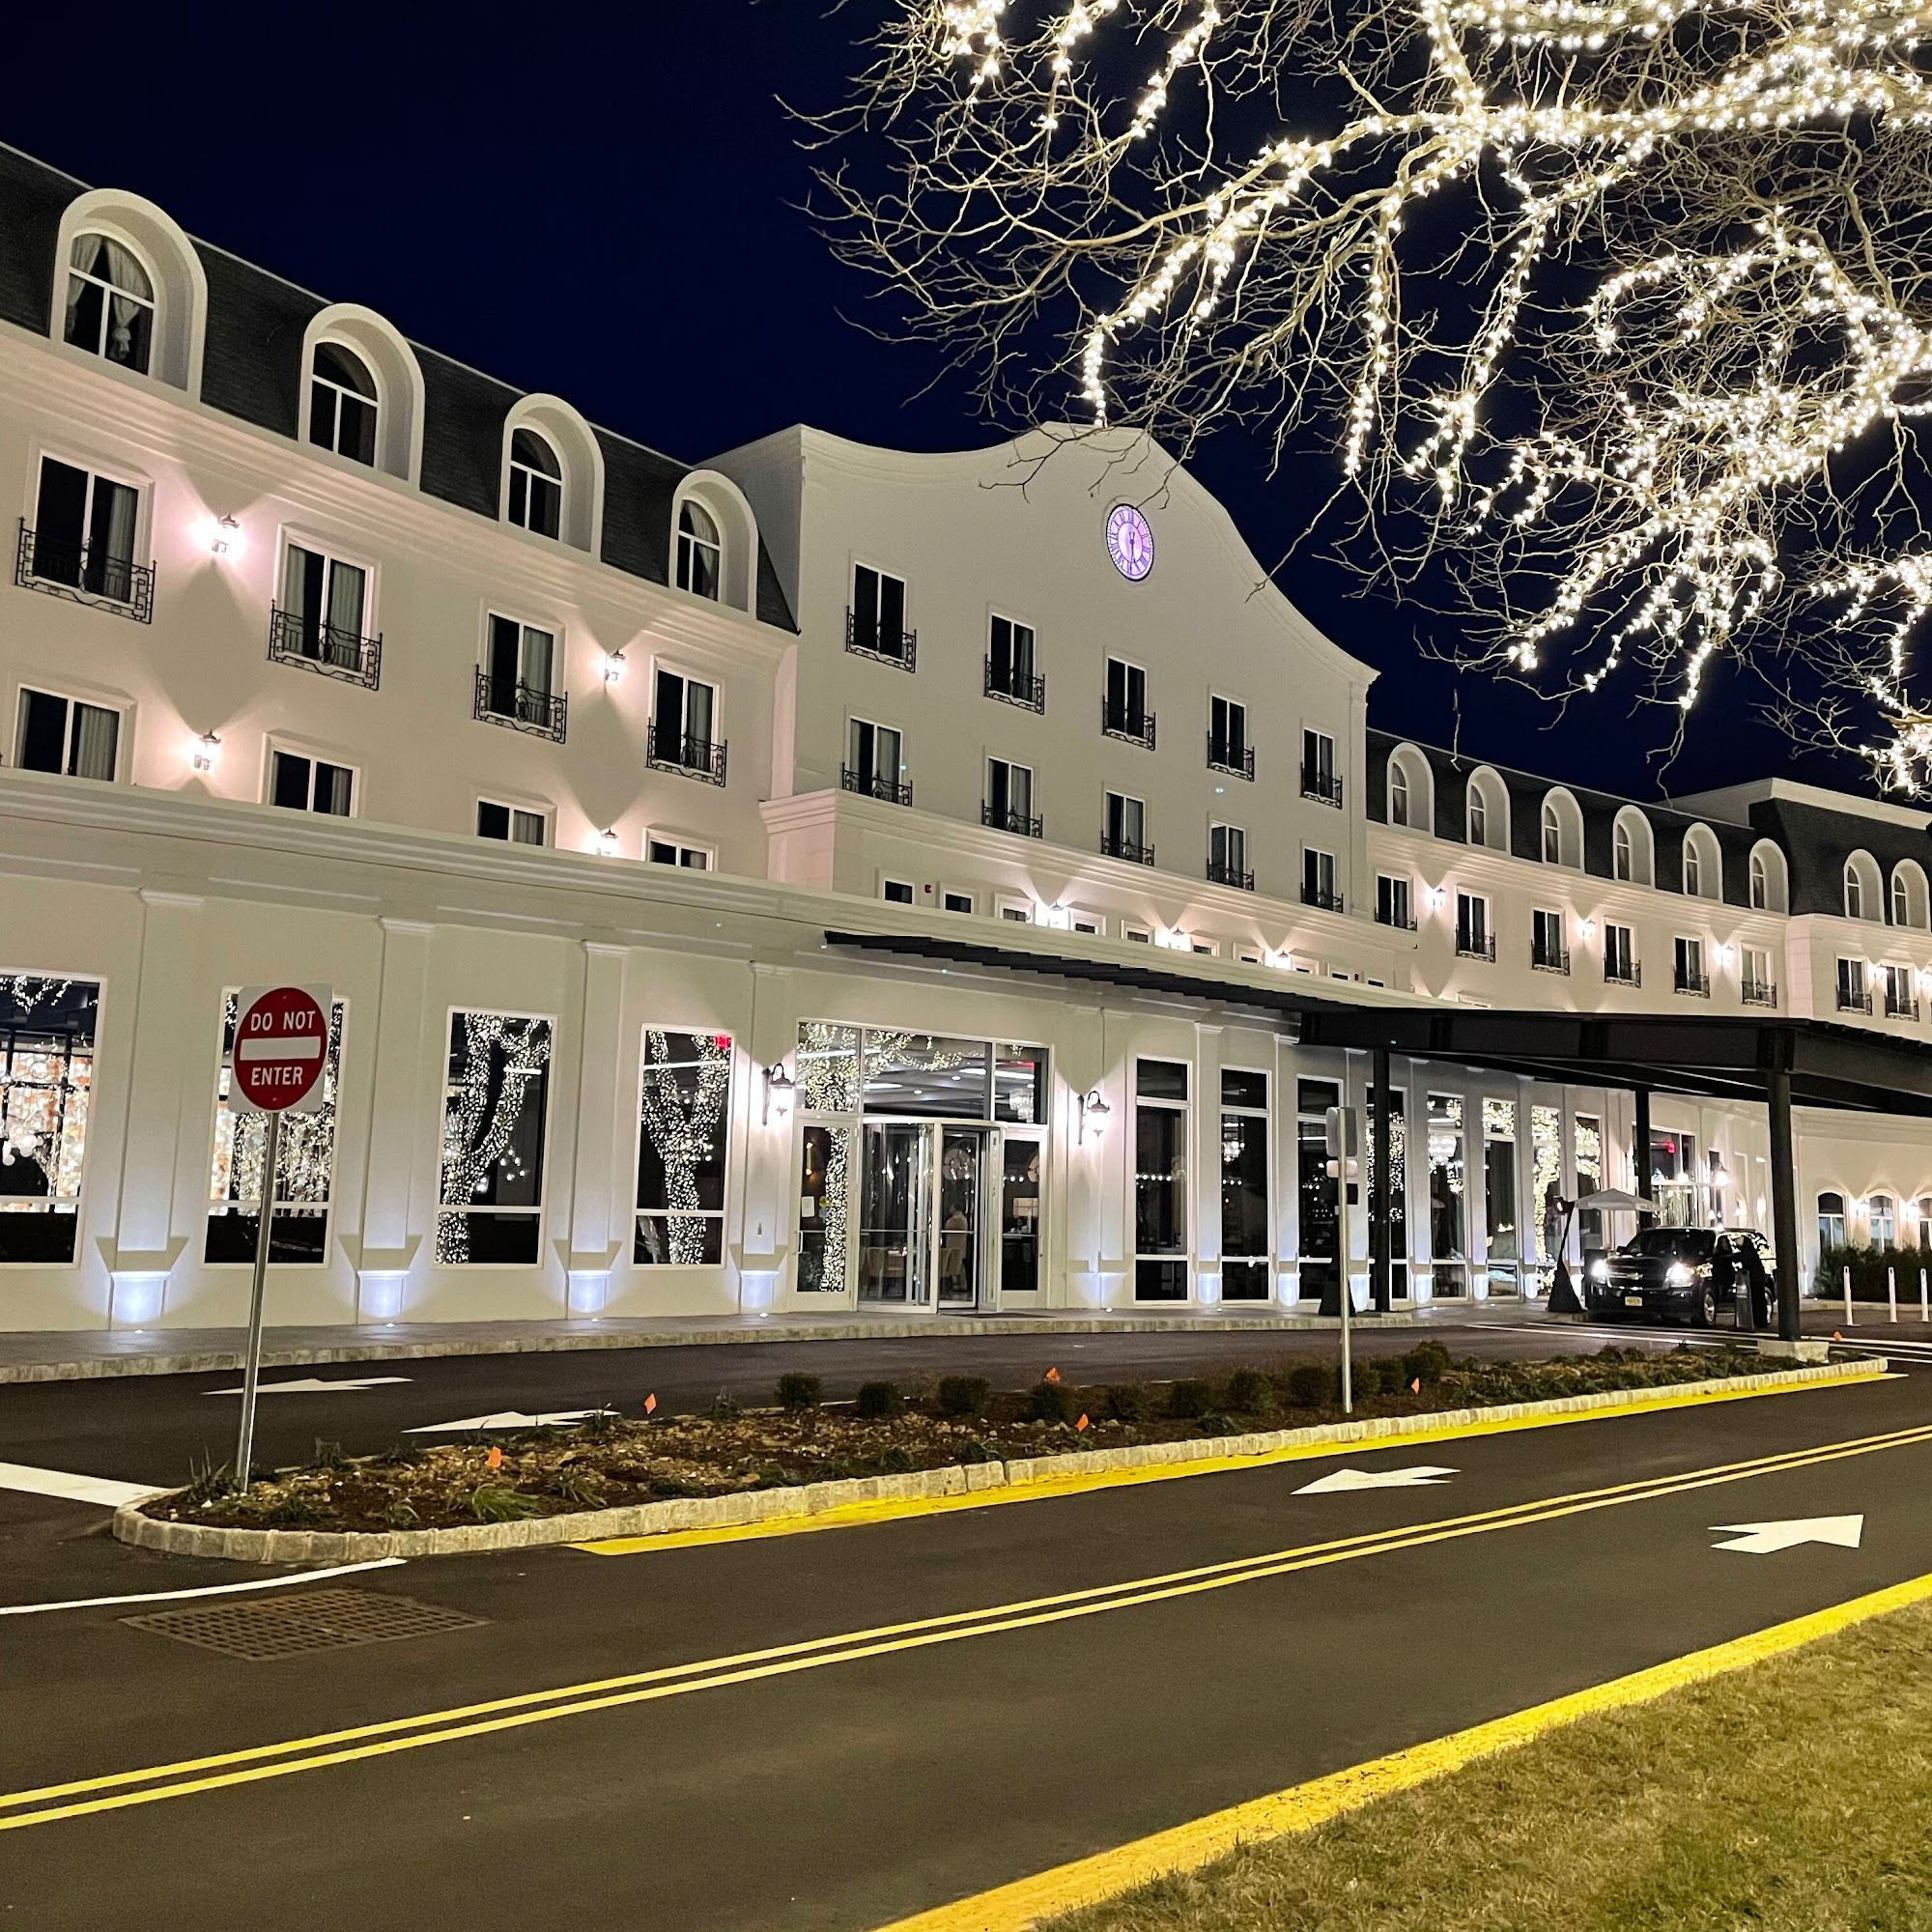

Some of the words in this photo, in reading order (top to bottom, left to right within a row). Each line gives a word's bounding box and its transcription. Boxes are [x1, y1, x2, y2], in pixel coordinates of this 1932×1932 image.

[250, 1012, 273, 1032] DO
[283, 1010, 316, 1030] NOT
[250, 1066, 303, 1086] ENTER
